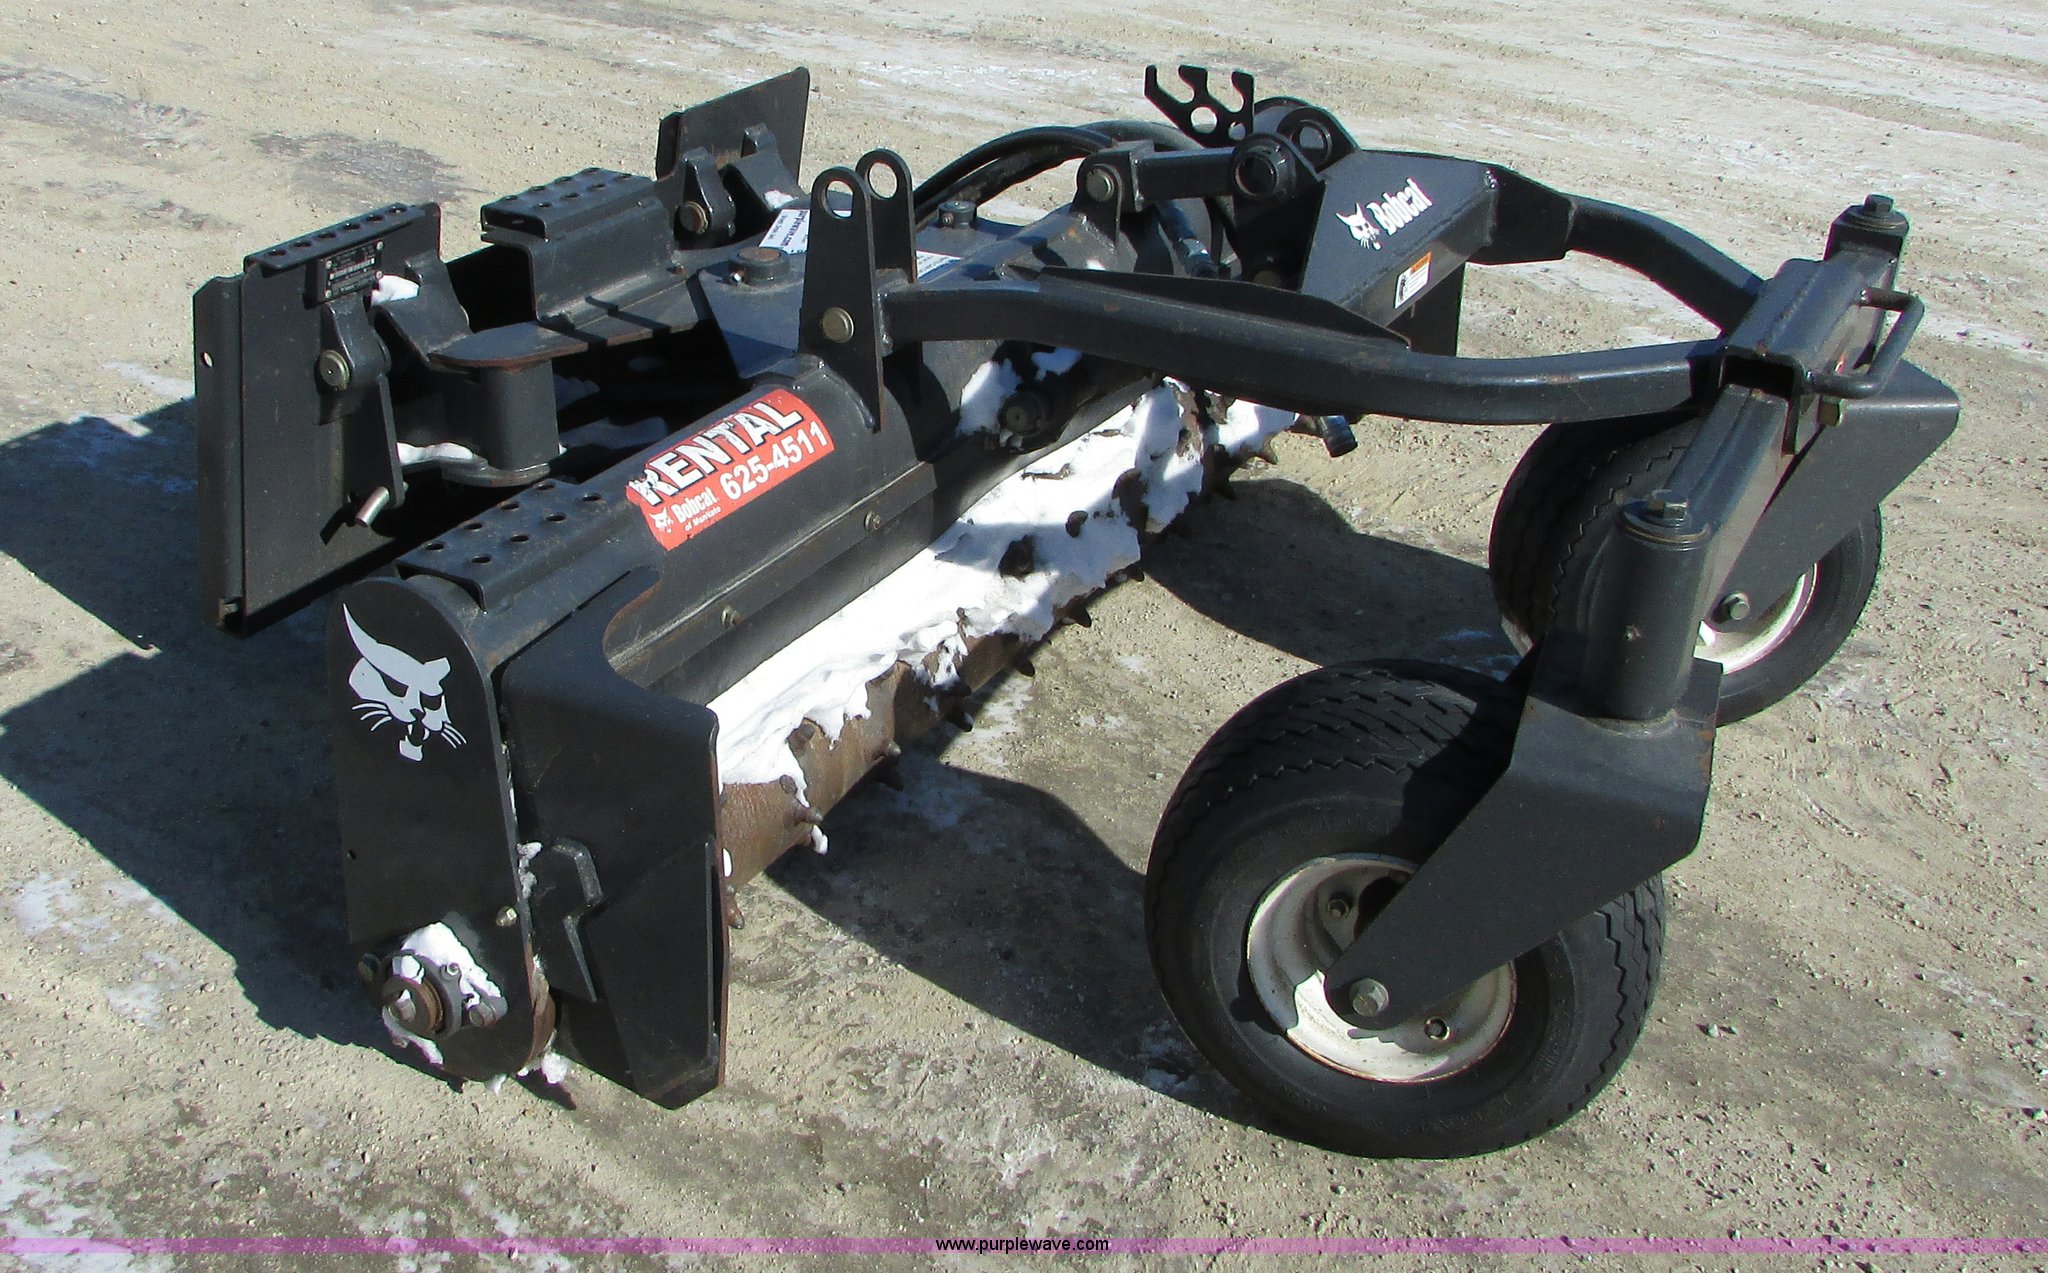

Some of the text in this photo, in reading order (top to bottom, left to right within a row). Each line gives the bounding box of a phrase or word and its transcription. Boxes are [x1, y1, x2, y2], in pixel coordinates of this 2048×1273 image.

[1366, 177, 1433, 236] Bobcat
[627, 401, 804, 506] RENTAL
[719, 420, 828, 500] 625-4511
[670, 486, 718, 523] Bobcat
